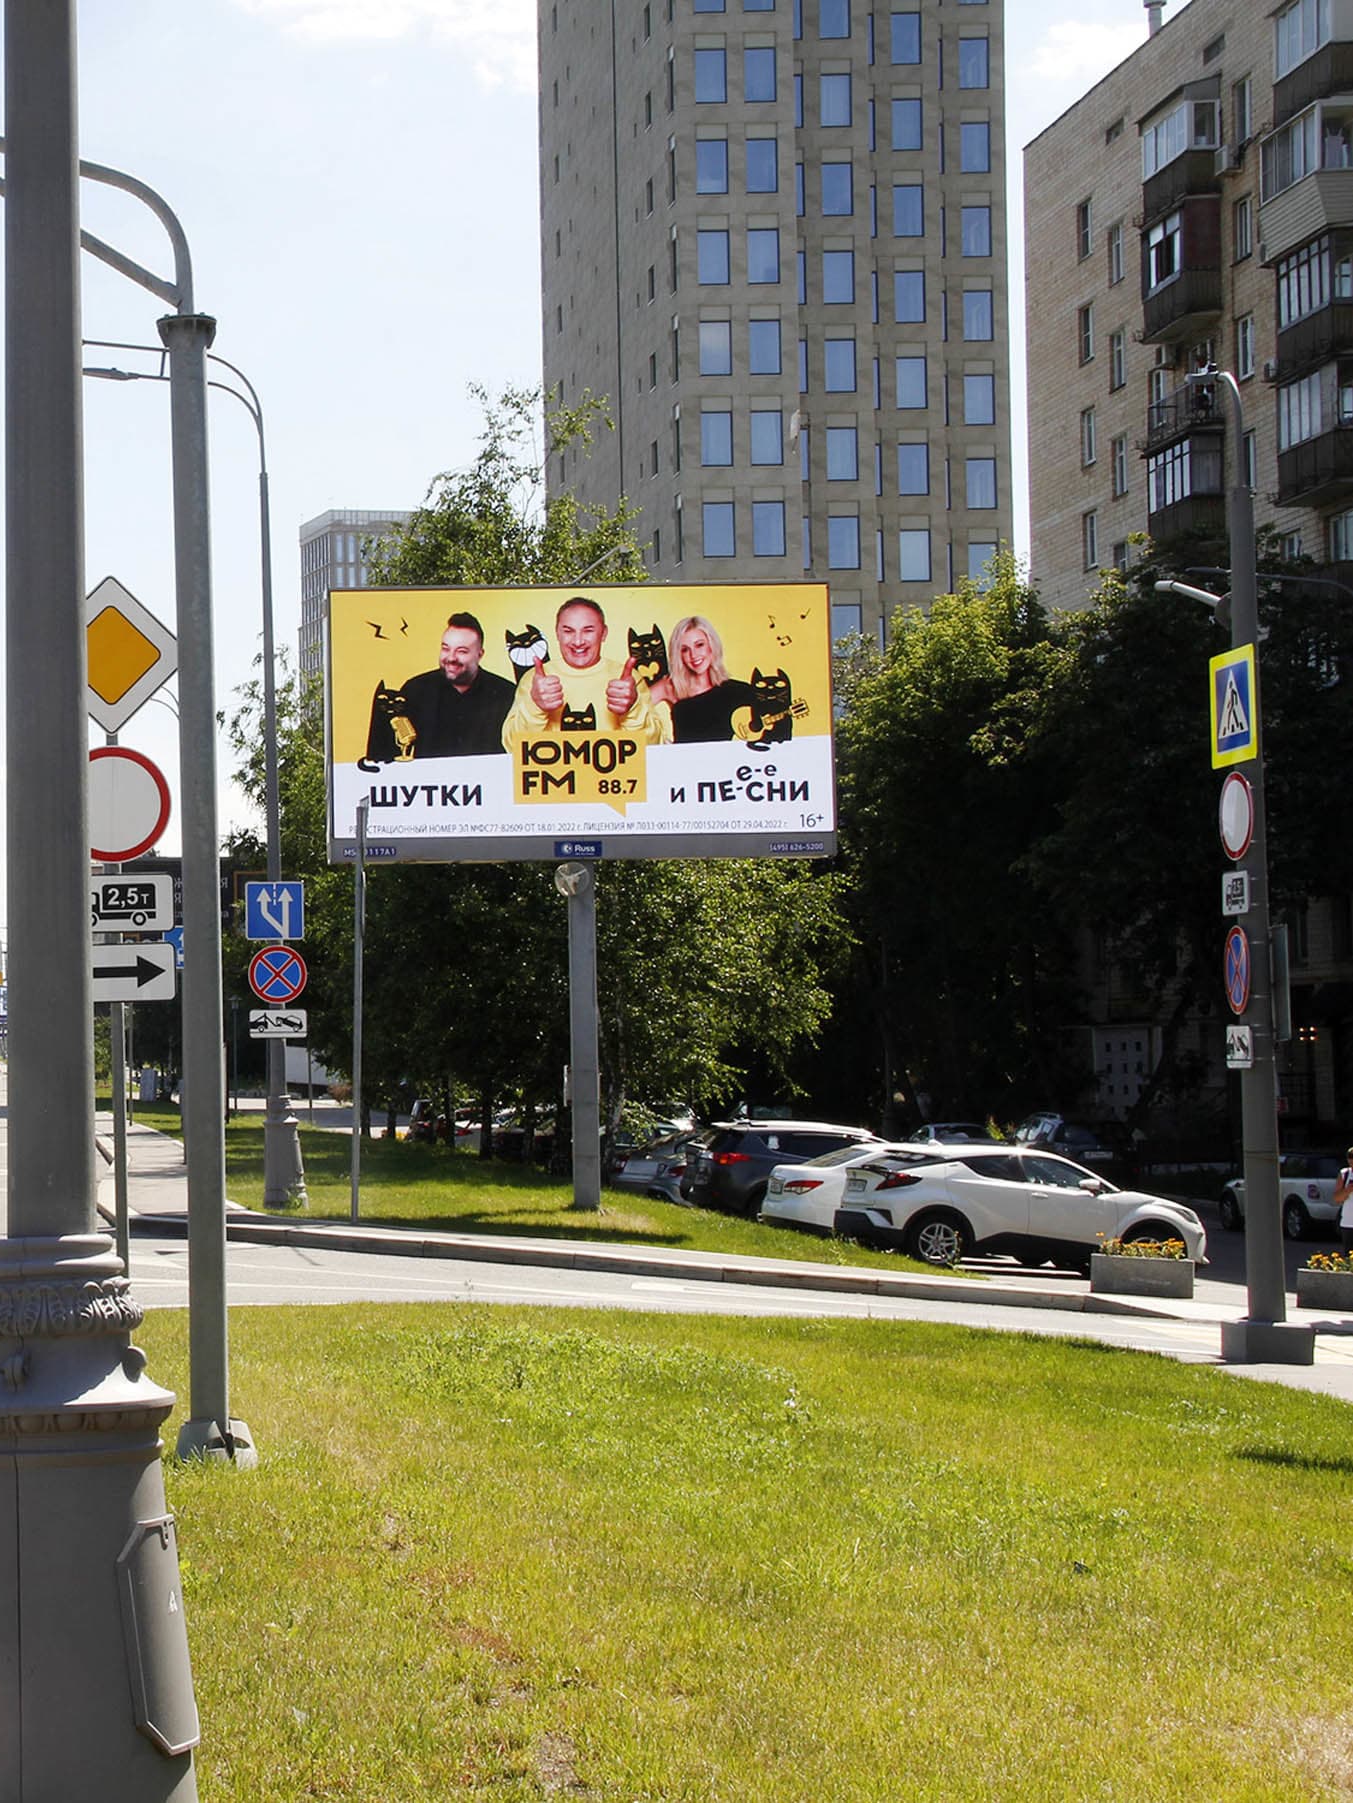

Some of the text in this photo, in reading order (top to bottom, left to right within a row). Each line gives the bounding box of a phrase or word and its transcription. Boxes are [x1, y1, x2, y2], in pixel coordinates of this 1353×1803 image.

[521, 739, 637, 774] ЮМОР
[522, 770, 576, 795] FM
[598, 779, 638, 794] 88.7
[370, 785, 482, 807] ШУТКИ
[800, 813, 825, 828] 16+
[574, 844, 596, 853] Russ
